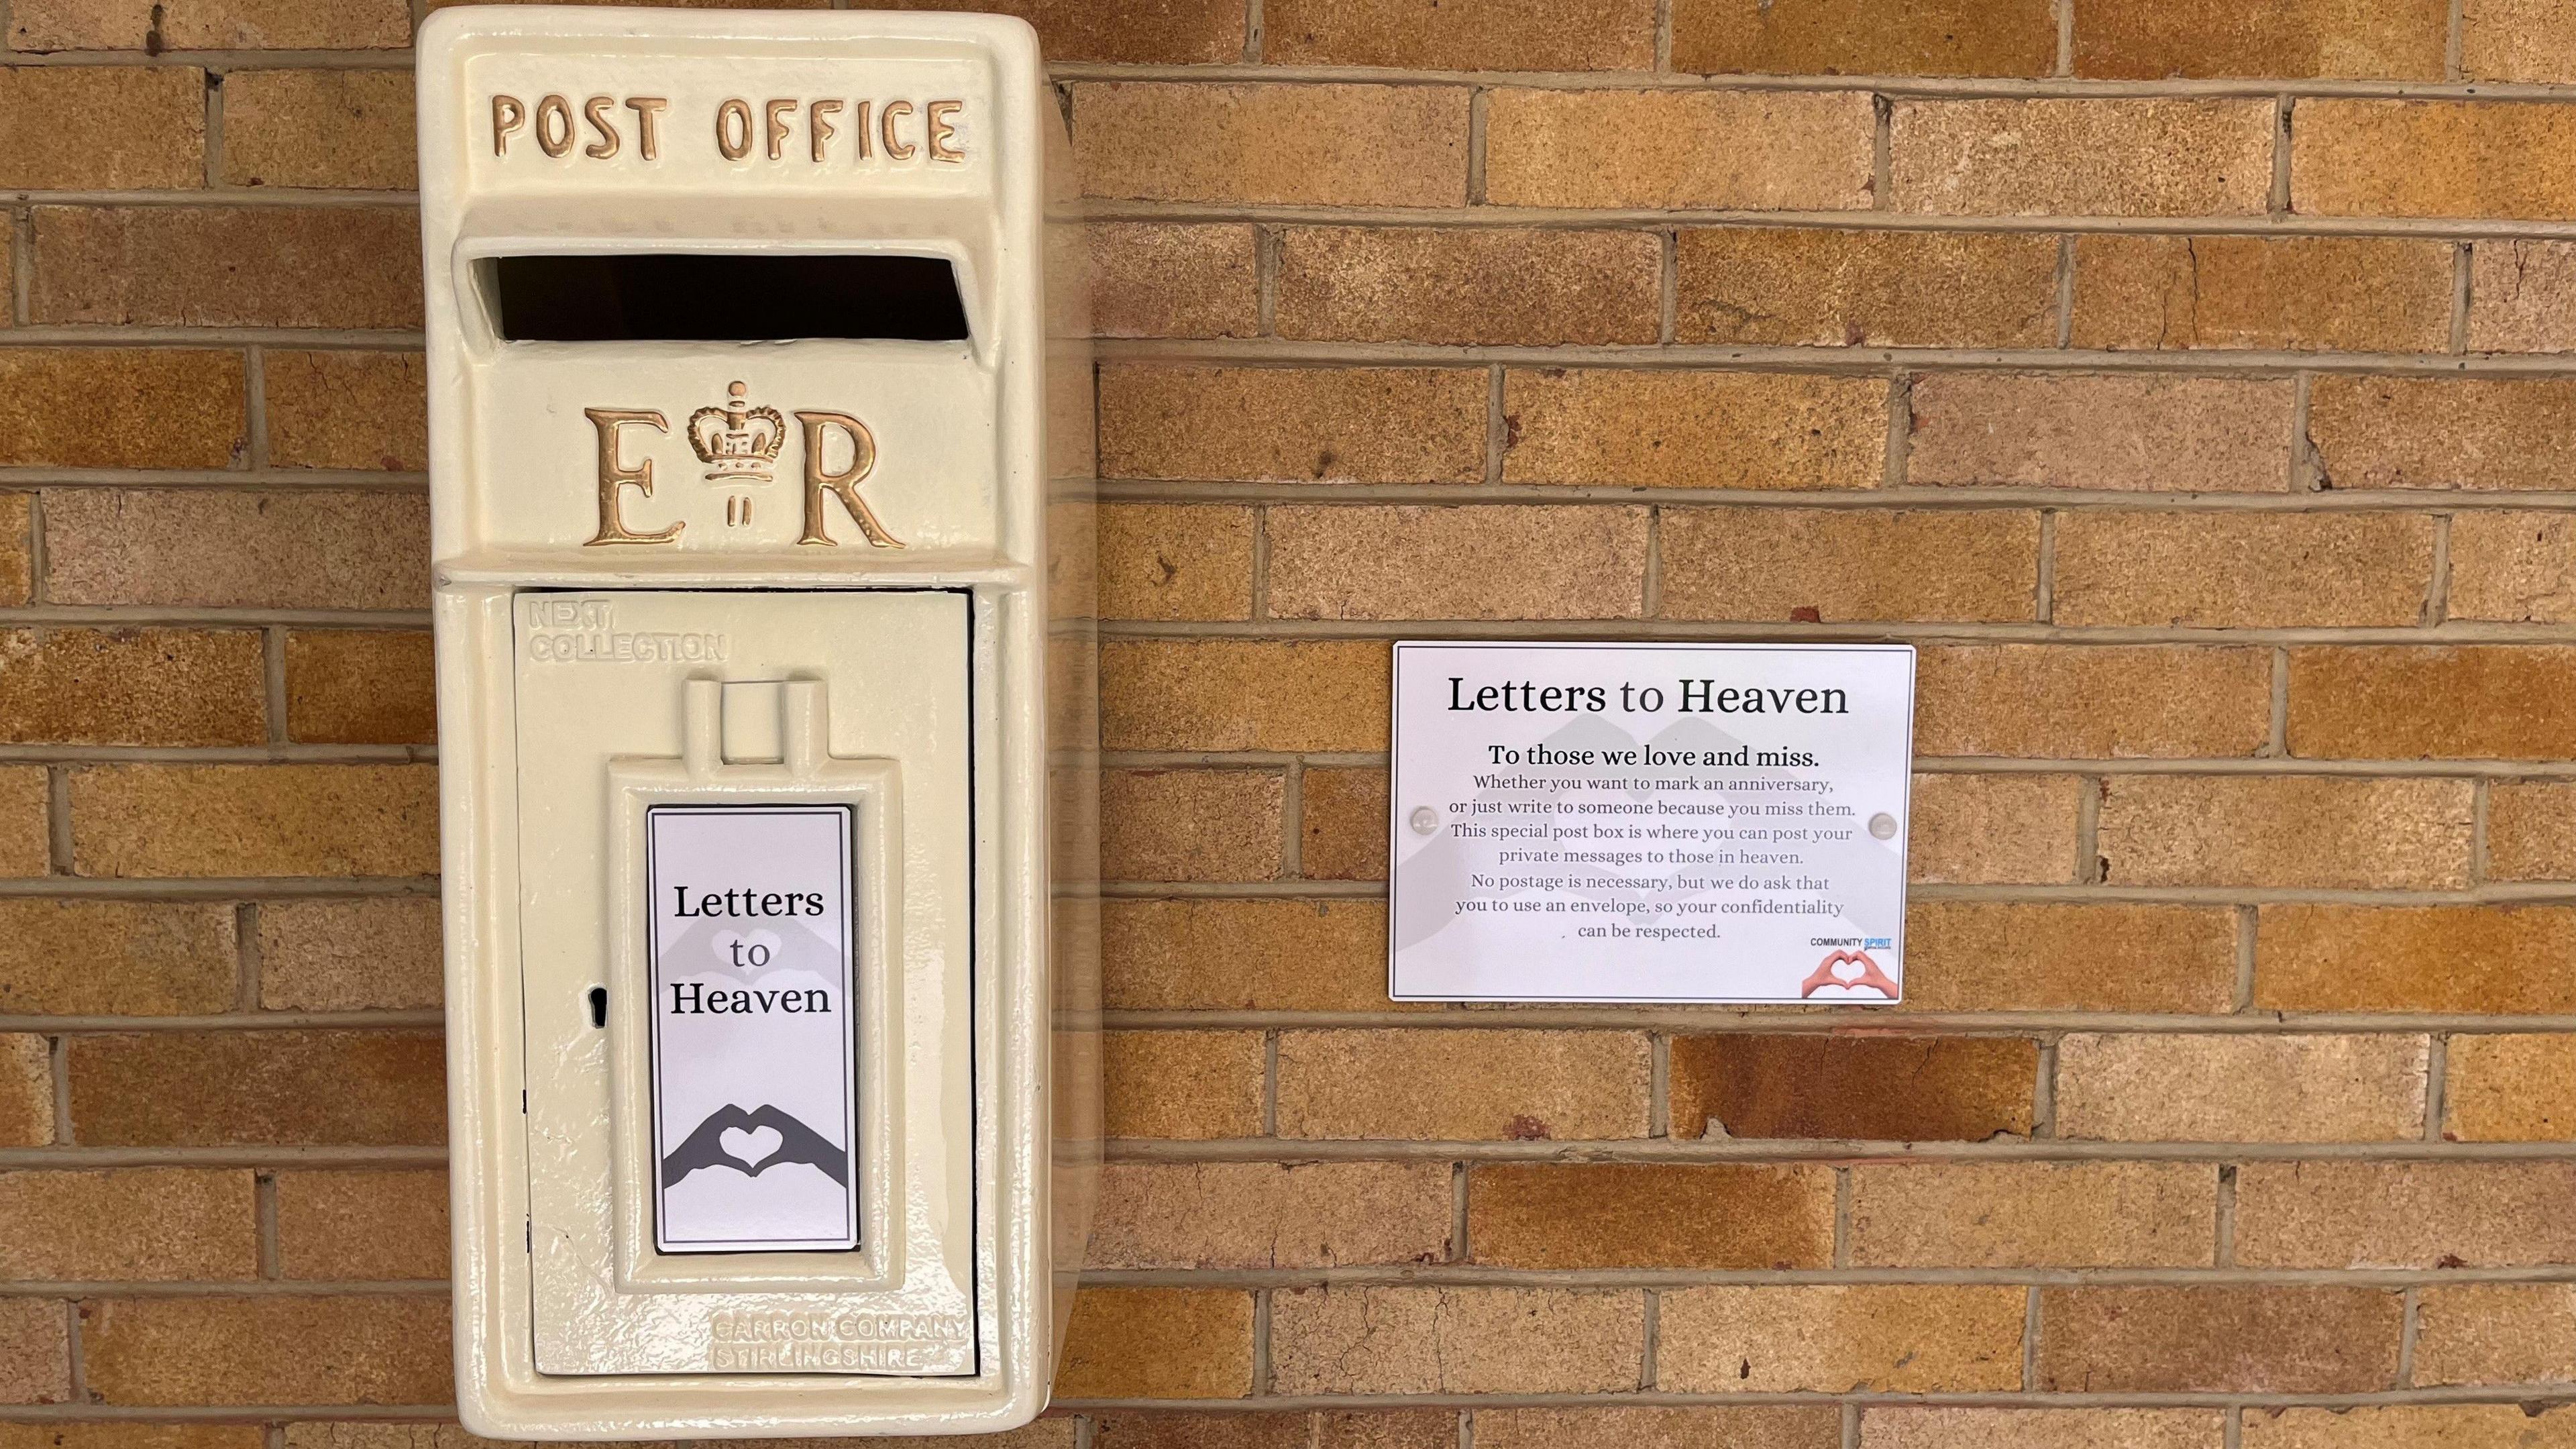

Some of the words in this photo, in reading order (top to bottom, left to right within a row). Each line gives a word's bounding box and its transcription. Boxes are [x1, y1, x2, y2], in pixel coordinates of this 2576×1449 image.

[490, 95, 667, 162] POST
[715, 97, 966, 164] OFFICE
[583, 407, 686, 547] E
[794, 411, 907, 549] R
[529, 599, 614, 629] NEXT
[529, 633, 728, 663] COLLECTION
[1448, 678, 1606, 712] Letters
[1620, 682, 1664, 712] to
[1678, 679, 1849, 714] Heaven
[1489, 745, 1519, 764] To
[1526, 743, 1594, 765] those
[1601, 751, 1637, 765] we
[1644, 744, 1696, 765] love
[1703, 745, 1750, 766] and
[1756, 746, 1819, 767] miss.
[1473, 774, 1546, 789] Whether
[1550, 780, 1582, 792] you
[1587, 778, 1628, 790] want
[1633, 778, 1650, 790] to
[1655, 775, 1699, 790] mark
[1704, 780, 1724, 790] an
[1729, 777, 1833, 794] anniversary,
[1450, 803, 1467, 812] or
[1471, 799, 1502, 816] just
[1508, 799, 1552, 813] write
[1556, 802, 1573, 814] to
[1578, 804, 1653, 814] someone
[1658, 800, 1724, 815] because
[1728, 805, 1760, 818] you
[1766, 802, 1803, 815] miss
[1809, 801, 1855, 816] them.
[1451, 822, 1486, 837] This
[1491, 823, 1548, 841] special
[1553, 826, 1589, 841] post
[1593, 824, 1624, 838] box
[1629, 824, 1642, 838] is
[1646, 824, 1698, 839] where
[1703, 829, 1734, 843] you
[1739, 830, 1768, 839] can
[1773, 828, 1807, 843] post
[1813, 830, 1852, 843] your
[1499, 848, 1558, 865] private
[1564, 853, 1642, 866] messages
[1647, 851, 1664, 863] to
[1669, 849, 1714, 863] those
[1719, 849, 1734, 863] in
[1739, 849, 1803, 863] heaven.
[1471, 874, 1494, 887] No
[1499, 876, 1563, 891] postage
[1568, 874, 1581, 888] is
[1587, 878, 1672, 892] necessary,
[1678, 875, 1705, 889] but
[1711, 879, 1733, 889] we
[1739, 875, 1758, 889] do
[1764, 875, 1792, 890] ask
[1796, 875, 1829, 890] that
[674, 886, 824, 917] Letters
[1455, 902, 1487, 915] you
[1492, 900, 1508, 911] to
[1513, 902, 1541, 912] use
[1546, 902, 1566, 912] an
[1570, 898, 1650, 916] envelope,
[1655, 903, 1672, 912] so
[1676, 903, 1717, 916] your
[1721, 899, 1844, 918] confidentiality
[1578, 927, 1607, 937] can
[1611, 923, 1631, 937] be
[1635, 924, 1720, 941] respected.
[1811, 937, 1862, 947] COMMUNITY
[1864, 938, 1892, 947] SPIRIT
[729, 939, 770, 967] to
[670, 983, 832, 1014] Heaven
[836, 1314, 968, 1342] COMPANY
[713, 1344, 926, 1369] STIRLINGSHIRE
